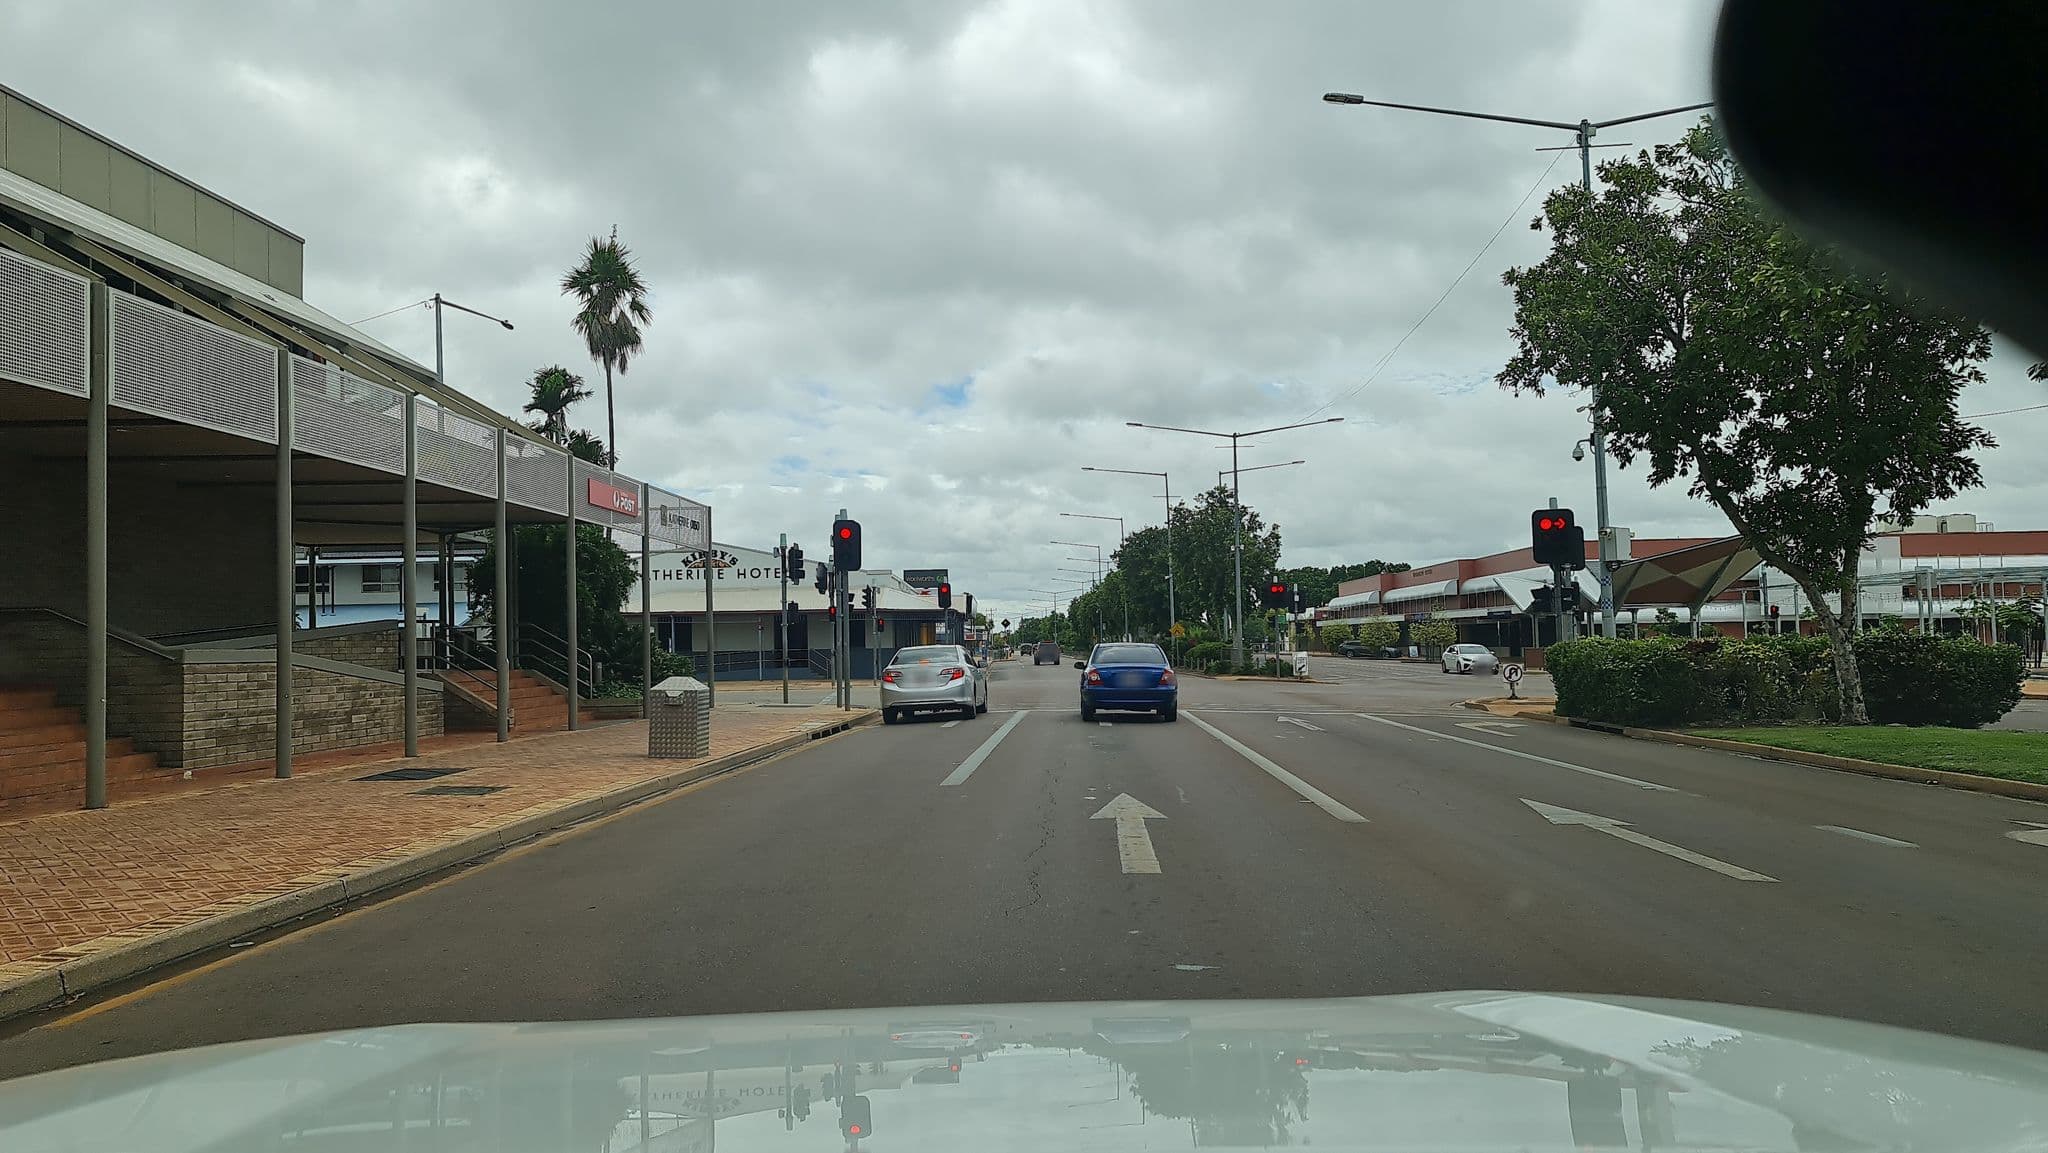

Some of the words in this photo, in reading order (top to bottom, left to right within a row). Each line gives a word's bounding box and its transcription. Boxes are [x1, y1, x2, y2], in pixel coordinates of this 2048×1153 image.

[620, 496, 635, 512] POST
[681, 550, 738, 567] KIRBY'S
[649, 569, 724, 581] THERIE
[737, 567, 781, 579] HOTE
